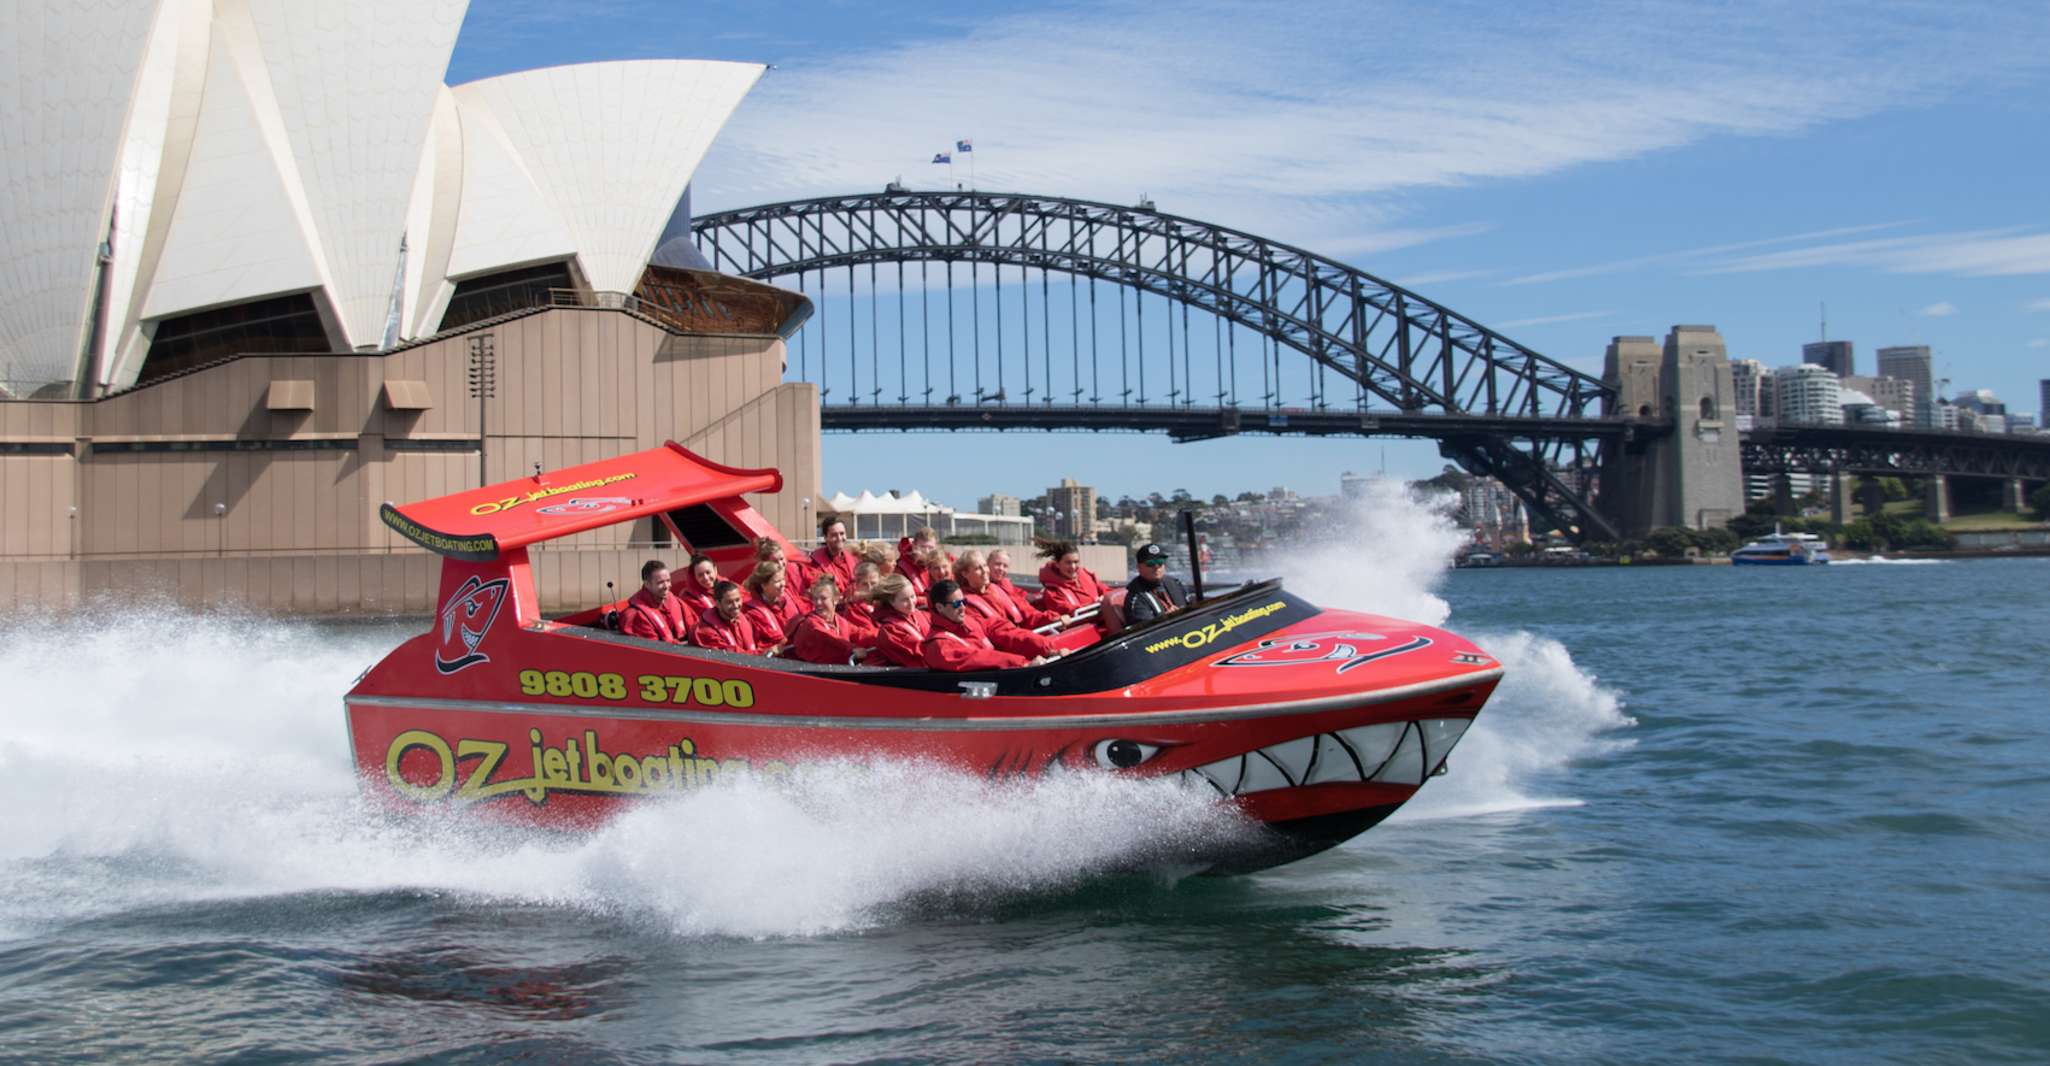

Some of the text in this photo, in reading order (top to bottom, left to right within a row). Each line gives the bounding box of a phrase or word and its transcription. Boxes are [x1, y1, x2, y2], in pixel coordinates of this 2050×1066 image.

[383, 508, 494, 552] WWW.OZJETBOATING.COM
[519, 669, 755, 708] 9808 3700
